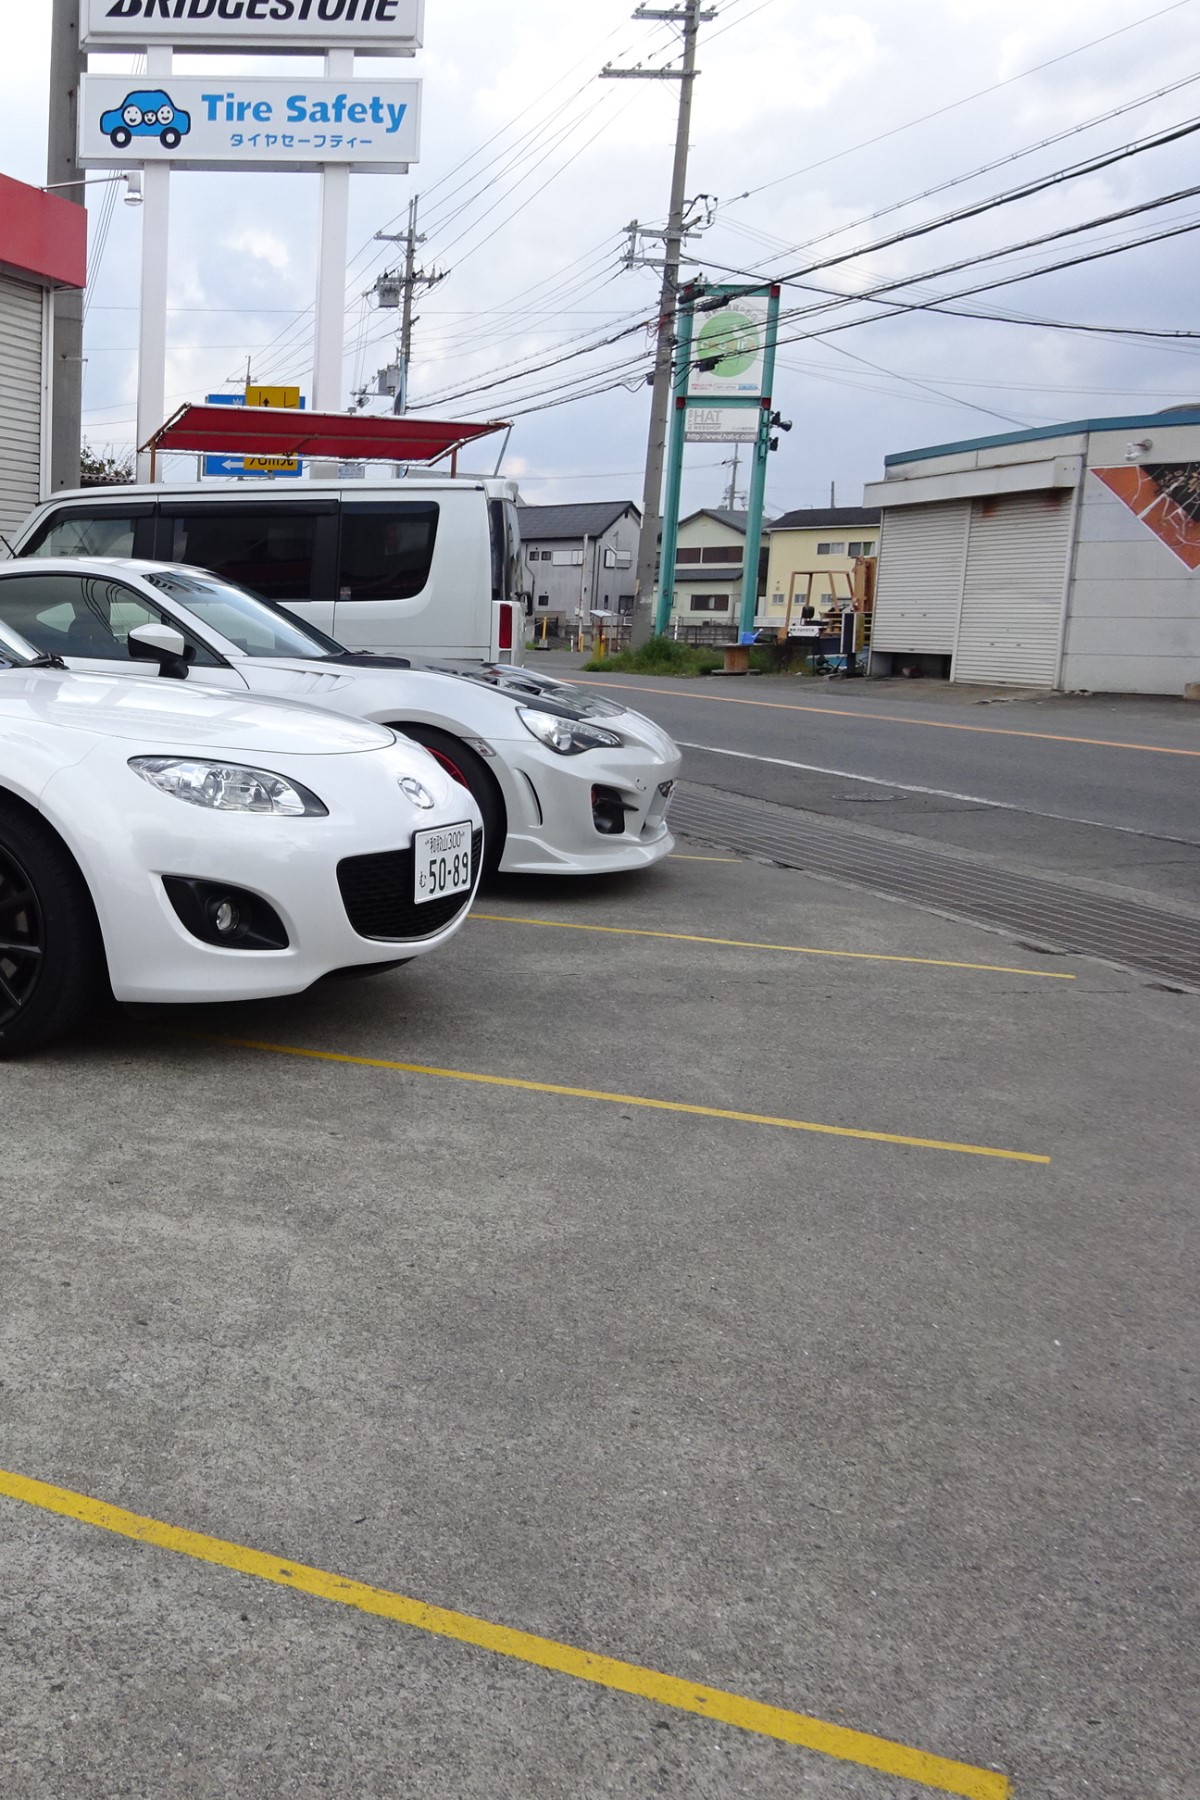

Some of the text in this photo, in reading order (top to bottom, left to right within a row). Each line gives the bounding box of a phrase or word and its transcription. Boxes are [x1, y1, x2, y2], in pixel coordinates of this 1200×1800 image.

[104, 0, 398, 22] BRIDGESTONE
[201, 92, 408, 133] Tire Safety
[230, 133, 373, 148] タイヤセーフティー
[694, 409, 723, 423] HAT
[429, 851, 469, 894] 50-89
